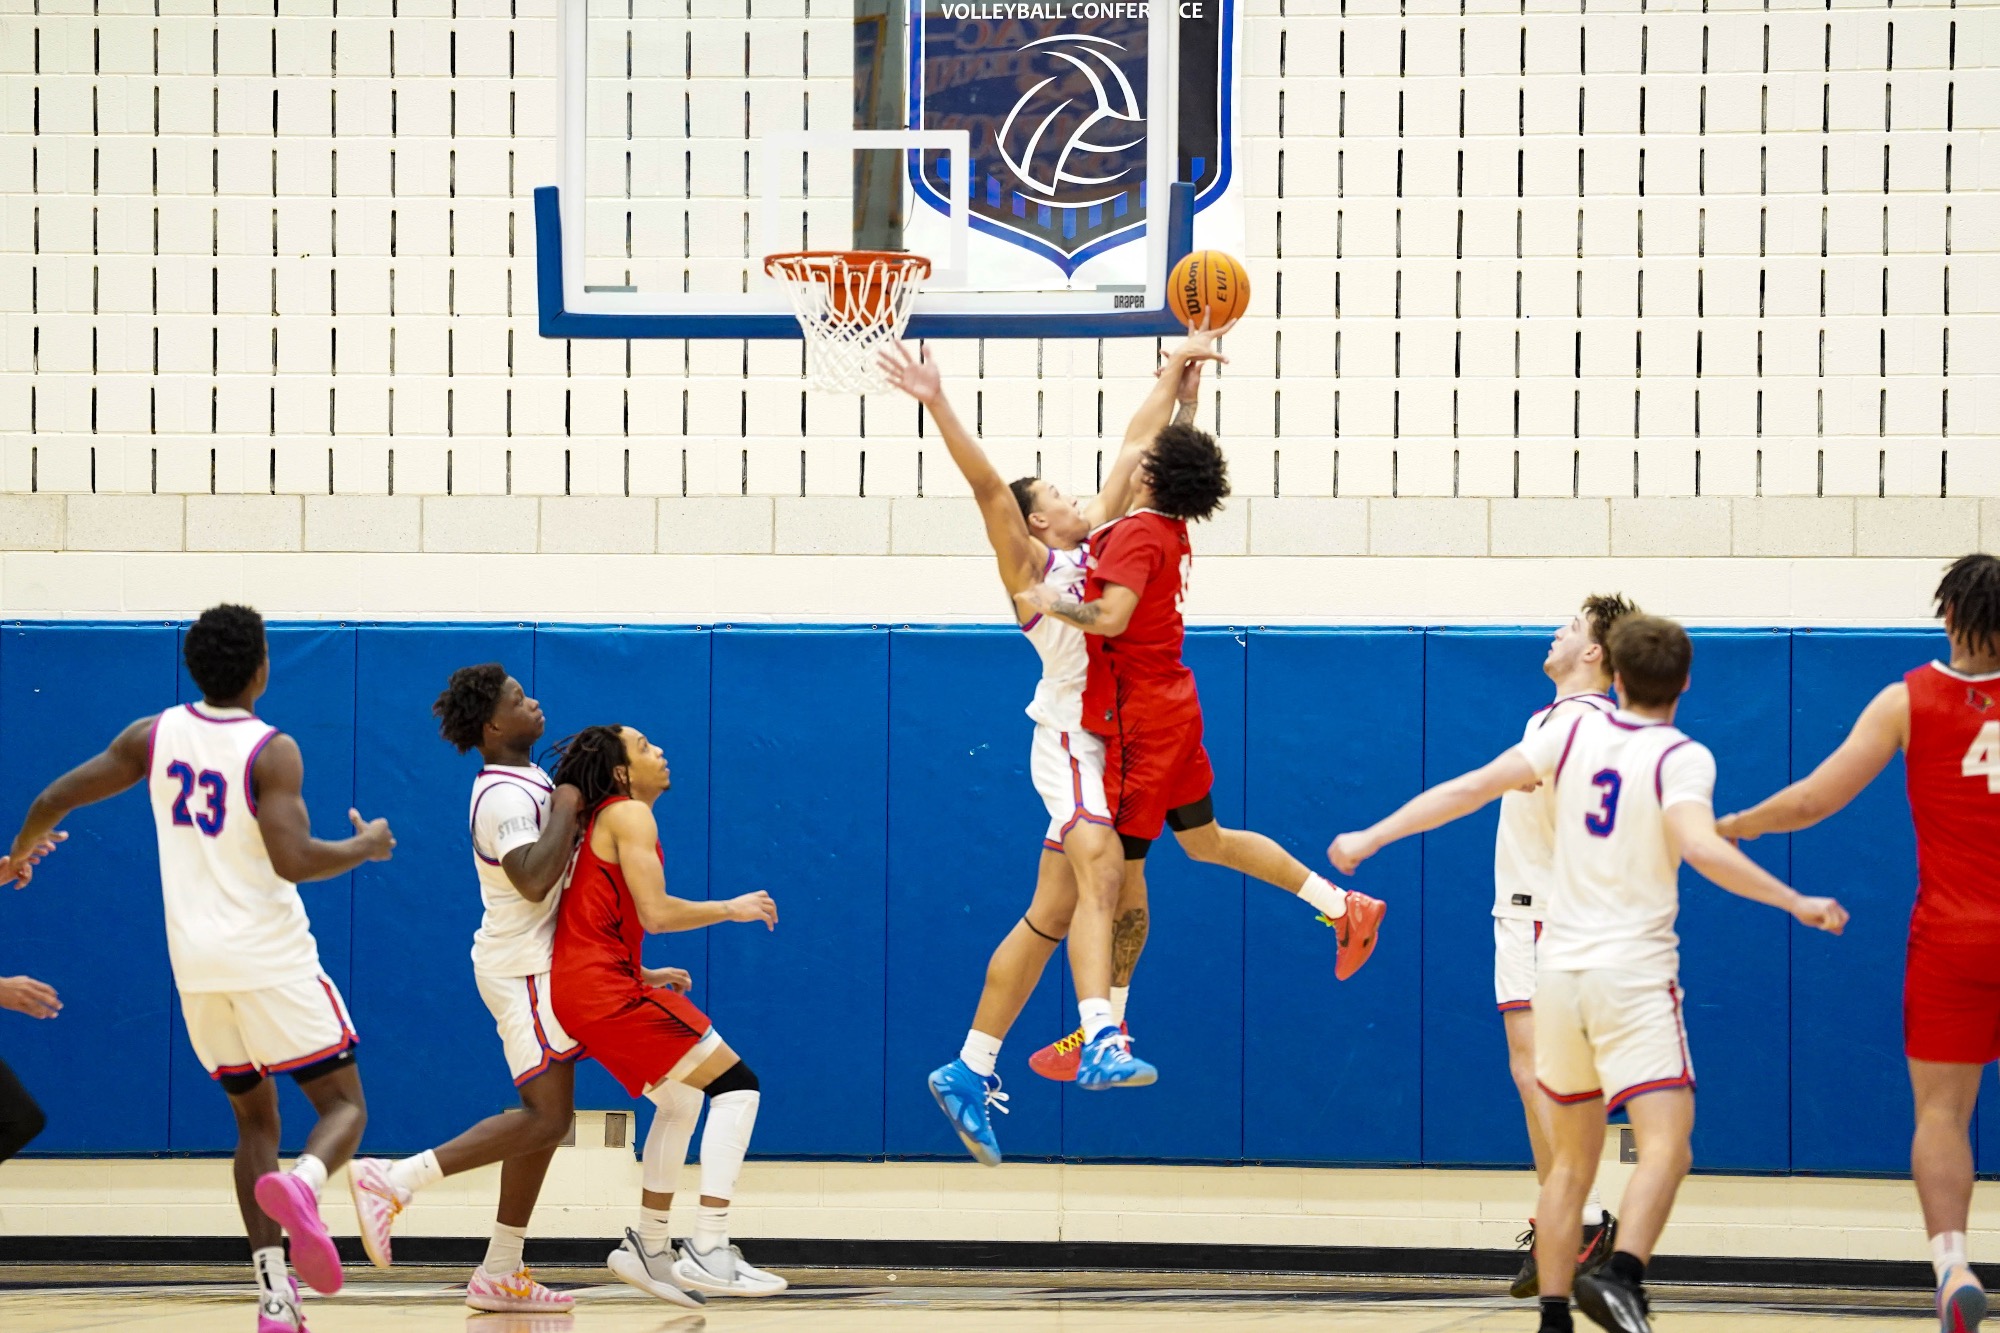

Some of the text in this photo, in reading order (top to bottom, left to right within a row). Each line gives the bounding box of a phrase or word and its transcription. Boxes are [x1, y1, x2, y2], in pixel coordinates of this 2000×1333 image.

[941, 2, 1203, 20] VOLLEYBALL CONFERCE
[1184, 261, 1201, 316] Wilson
[1962, 720, 2000, 795] 4
[166, 758, 228, 838] 23
[1584, 768, 1622, 838] 3
